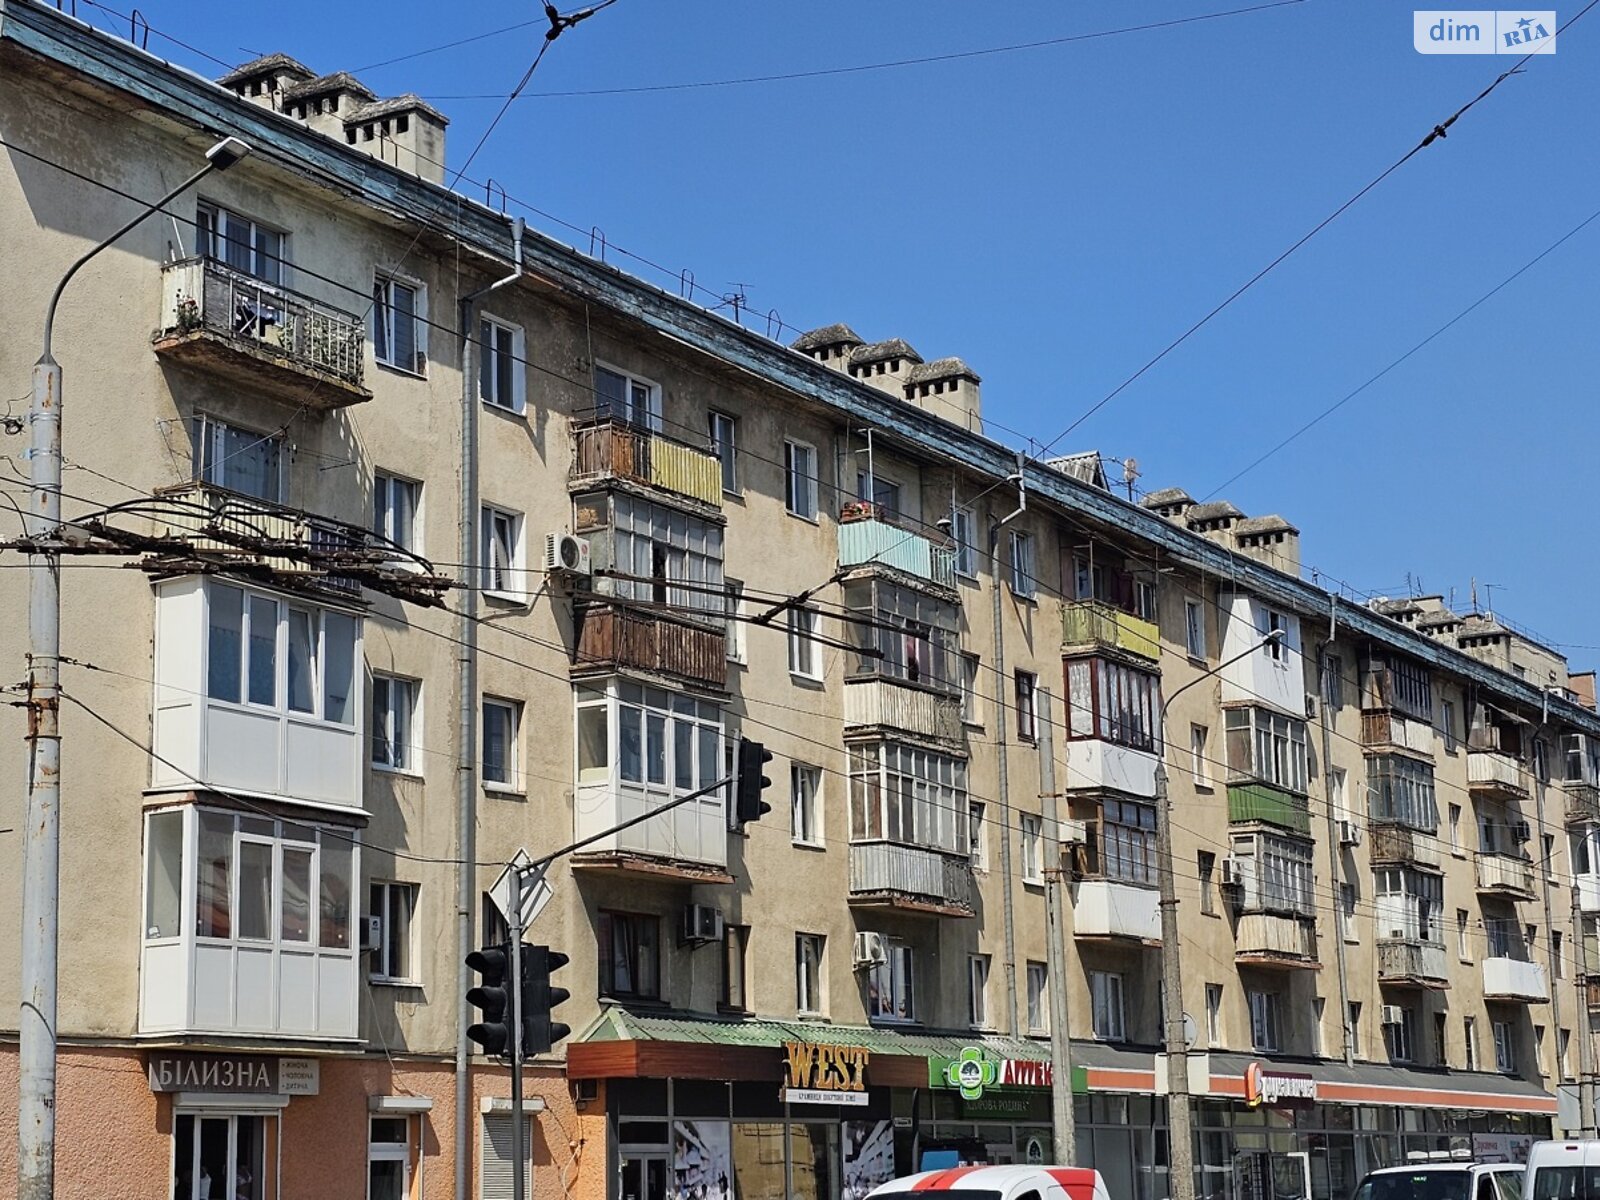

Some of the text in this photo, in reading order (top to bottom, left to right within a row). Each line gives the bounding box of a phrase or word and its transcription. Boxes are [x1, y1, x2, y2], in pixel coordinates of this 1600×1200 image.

[159, 1059, 271, 1088] БІЛИЗНА
[784, 1041, 870, 1092] WEST
[1003, 1058, 1053, 1086] АПТЕК
